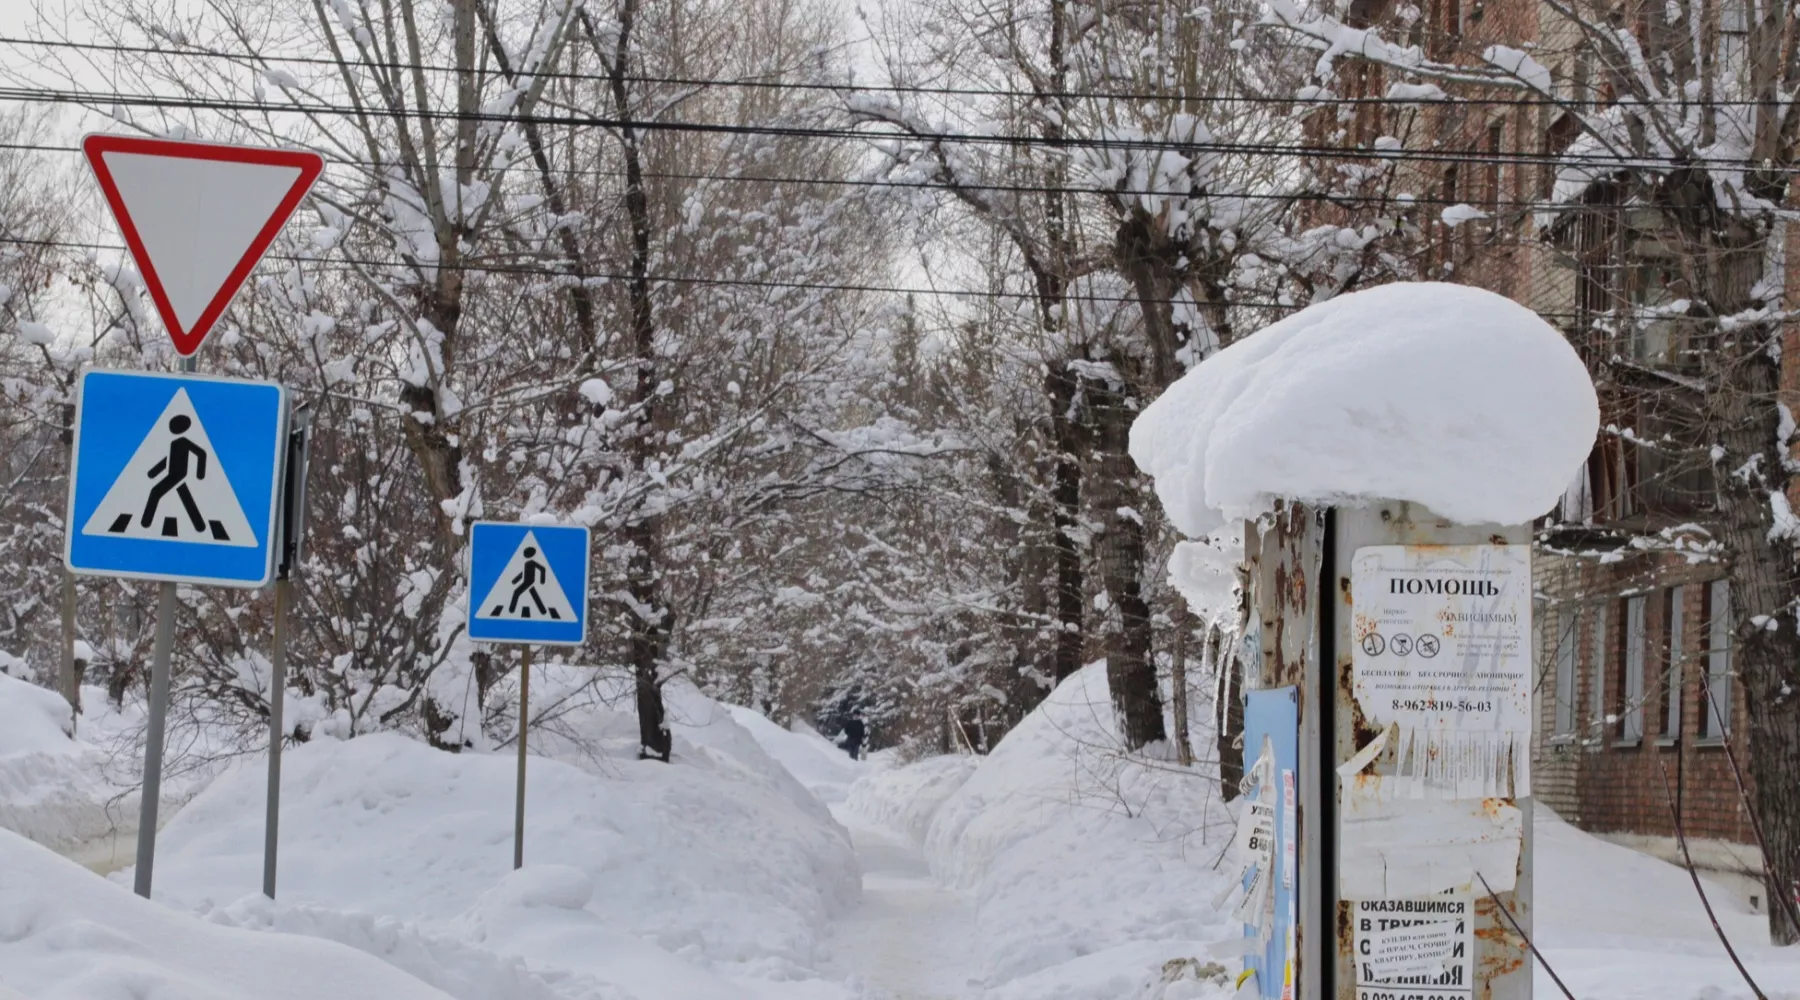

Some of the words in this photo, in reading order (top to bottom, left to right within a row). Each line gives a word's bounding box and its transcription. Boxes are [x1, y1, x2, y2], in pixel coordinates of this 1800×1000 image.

[1390, 578, 1499, 598] ПОМОЩЬ
[1361, 669, 1412, 677] БЕСПЛАТНО!
[1418, 671, 1468, 679] БЕССРОЧНО!
[1475, 672, 1525, 680] АНОНИМНО!
[1392, 699, 1492, 712] 8-962-819-56-03
[1361, 901, 1465, 914] ОКАЗАВШИМСЯ
[1360, 918, 1372, 931] В
